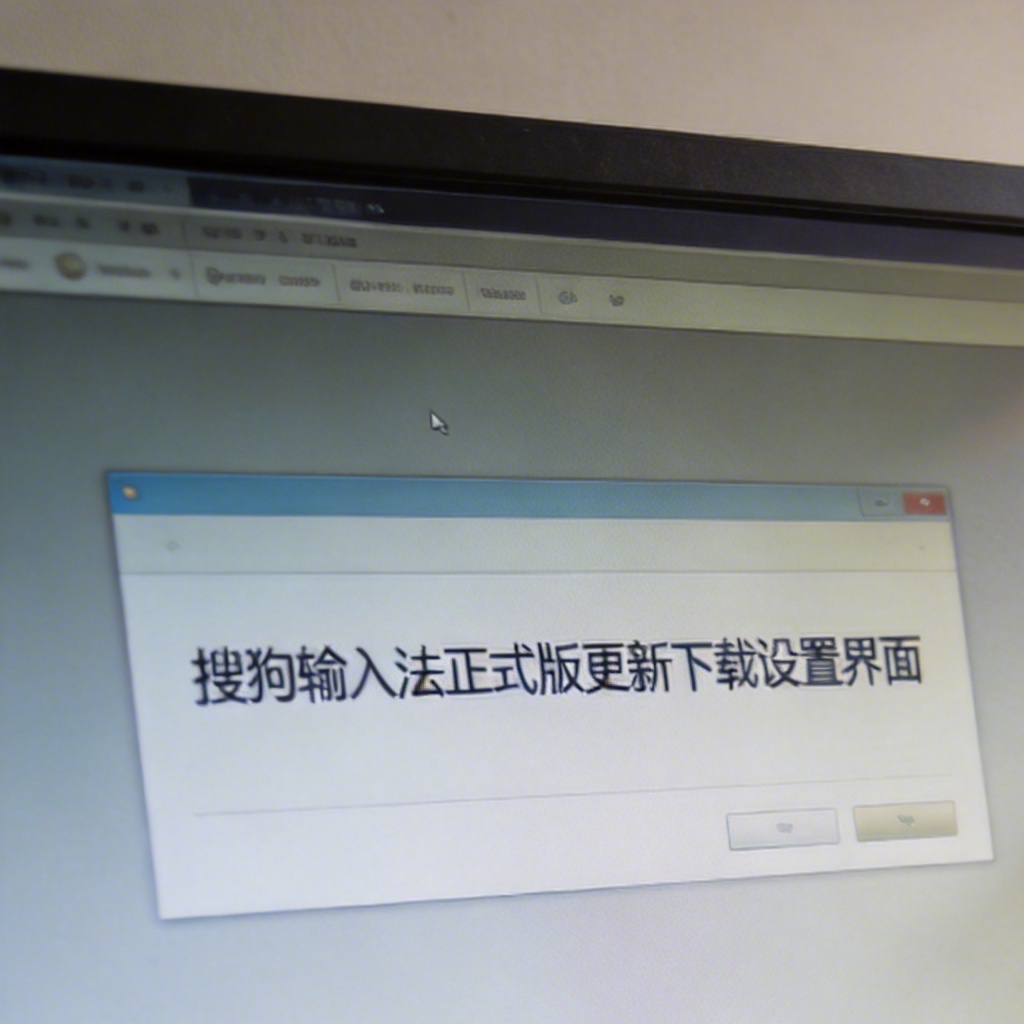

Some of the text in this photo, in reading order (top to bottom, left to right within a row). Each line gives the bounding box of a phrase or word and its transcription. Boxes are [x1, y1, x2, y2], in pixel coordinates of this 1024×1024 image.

[191, 636, 922, 706] 搜狗输入法正式版更新下载设置界面
